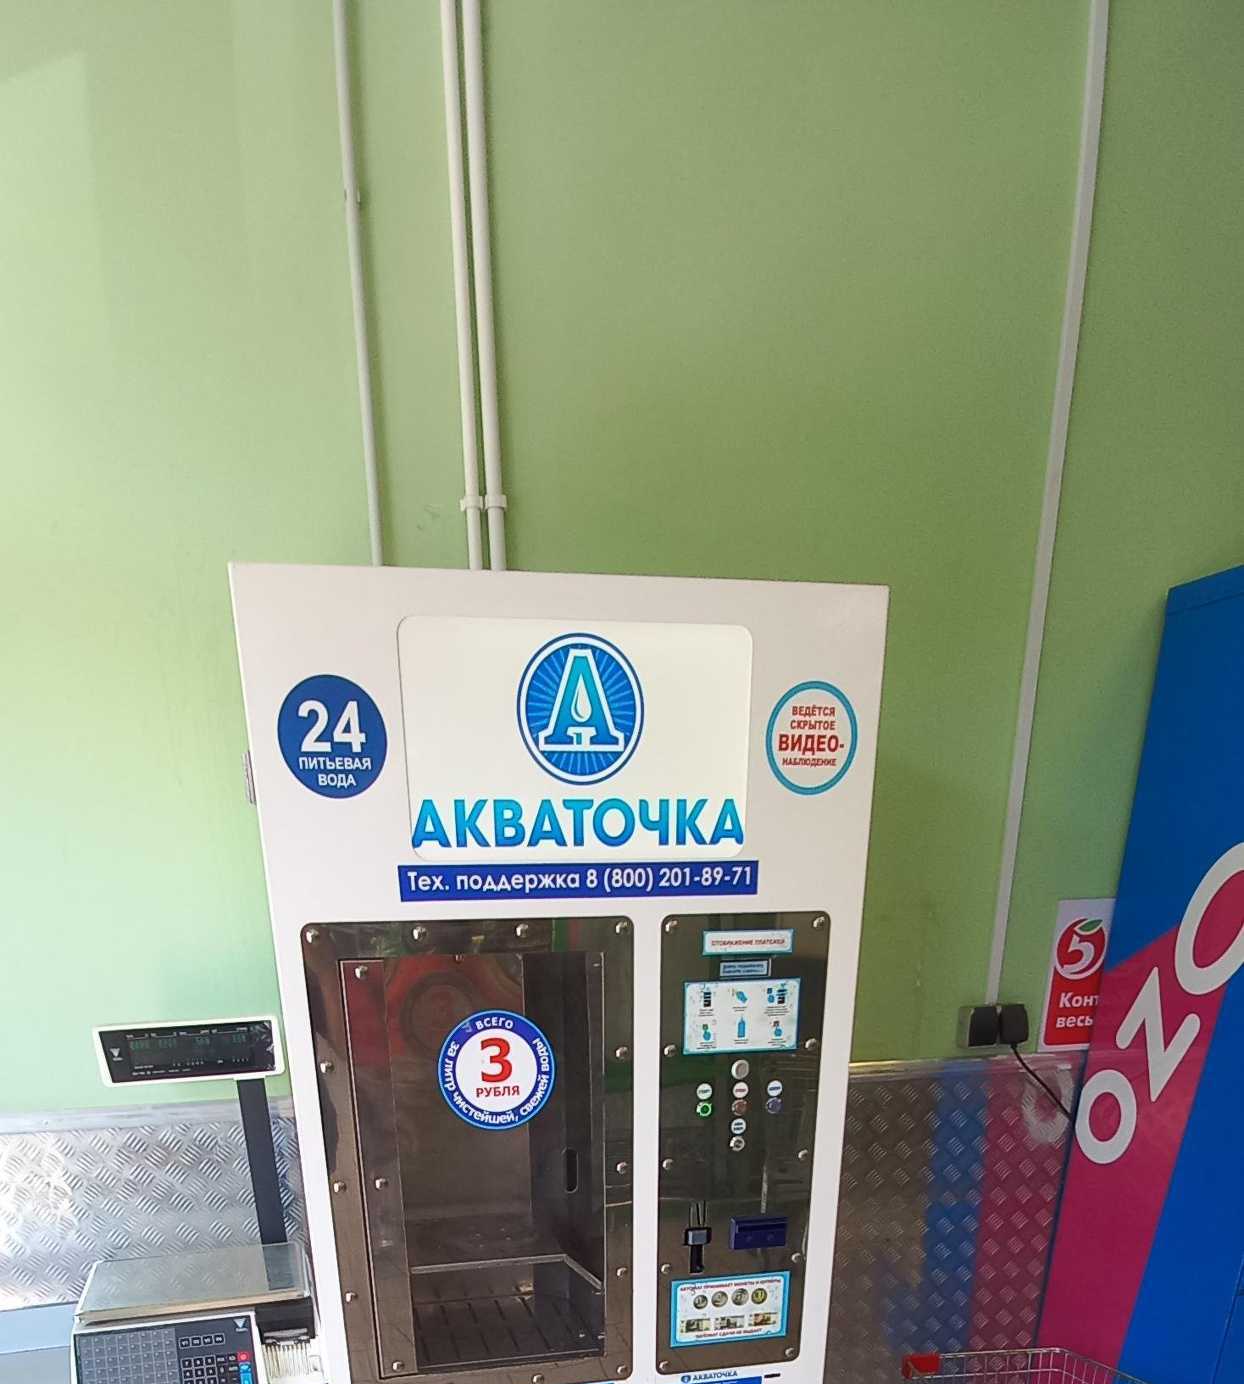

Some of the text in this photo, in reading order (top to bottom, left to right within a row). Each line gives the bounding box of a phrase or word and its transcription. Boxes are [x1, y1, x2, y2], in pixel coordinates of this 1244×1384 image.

[792, 705, 835, 718] ВЕДЁТСЯ
[298, 700, 366, 753] 24
[790, 720, 836, 730] СКРЫТОЕ
[778, 734, 844, 756] ВИДЕО-
[298, 757, 372, 770] ПИТЬЕВАЯ
[782, 758, 837, 767] НАБЛЮДЕНИЕ
[318, 774, 356, 788] ВОДА
[411, 797, 744, 849] АКВАТОЧКА
[407, 865, 751, 894] Тех. поддержка 8 (800) 201-89-71
[475, 1016, 514, 1030] ВСЕГО
[1056, 1015, 1093, 1028] весь
[447, 1041, 460, 1058] за
[533, 1037, 550, 1072] воды
[480, 1037, 513, 1082] 3
[444, 1058, 457, 1091] литр
[476, 1085, 520, 1098] РУБЛЯ
[519, 1074, 550, 1116] свежей
